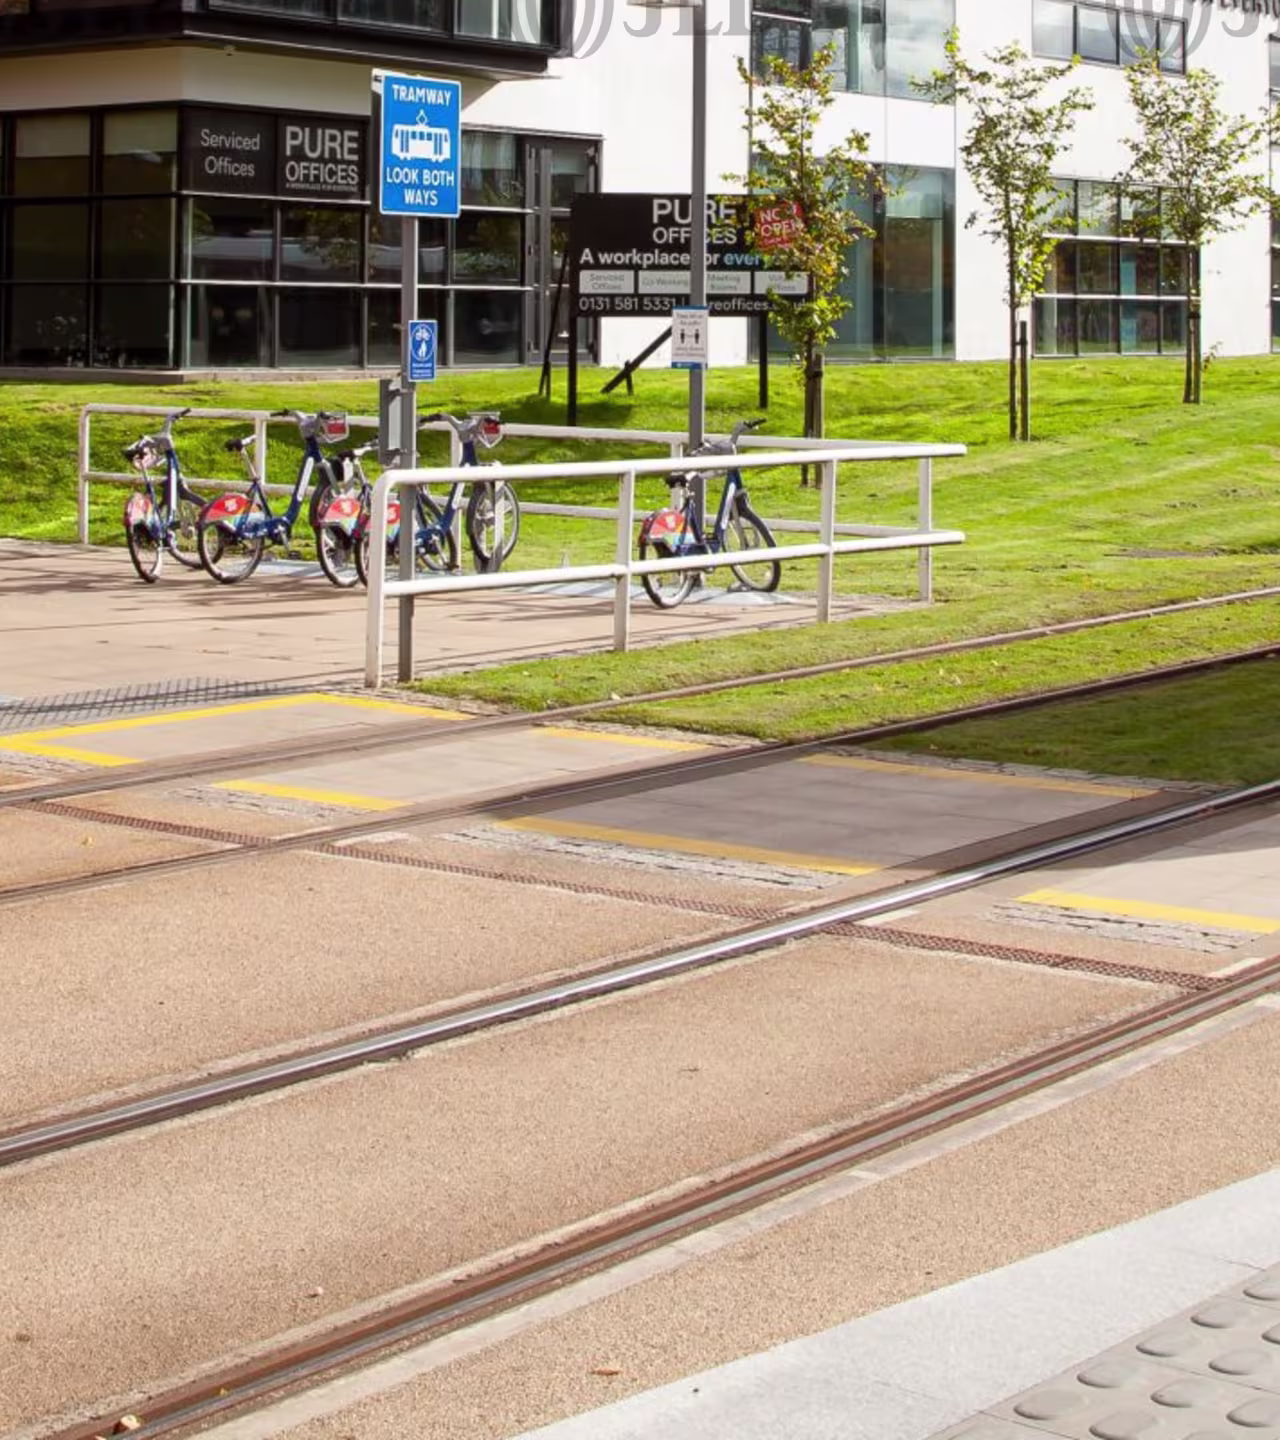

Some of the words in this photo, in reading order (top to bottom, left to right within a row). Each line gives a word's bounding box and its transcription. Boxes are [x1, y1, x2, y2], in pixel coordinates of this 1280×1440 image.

[392, 84, 452, 106] TRAMWAY
[201, 128, 260, 150] Serviced
[286, 126, 359, 160] PURE
[204, 156, 255, 176] Offices
[286, 161, 359, 184] OFFICES
[386, 167, 419, 184] LOOK
[422, 169, 454, 186] BOTH
[404, 188, 438, 206] WAYS
[652, 198, 737, 225] PURE
[652, 227, 738, 245] OFFES
[579, 247, 594, 264] A
[598, 248, 690, 269] workplace
[579, 296, 610, 310] 0131
[614, 296, 639, 311] 581
[643, 296, 676, 311] 5331
